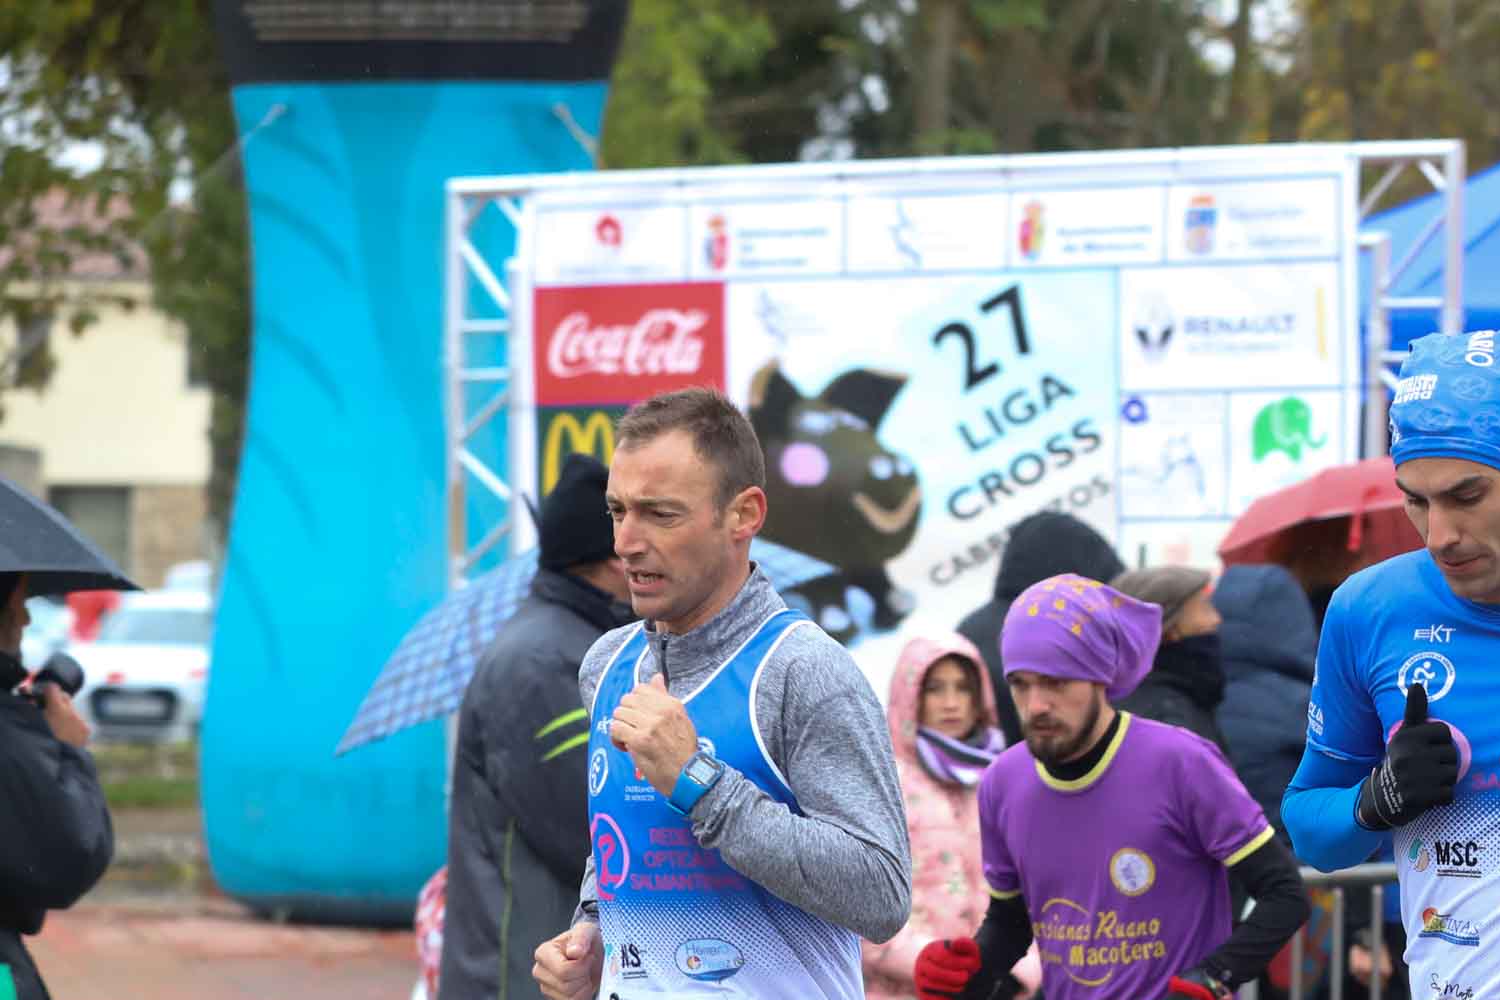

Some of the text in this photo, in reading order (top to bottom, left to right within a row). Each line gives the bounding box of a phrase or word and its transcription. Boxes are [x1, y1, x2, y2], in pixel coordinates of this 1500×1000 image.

[933, 283, 1032, 391] 27
[1184, 314, 1297, 334] RENAULT
[958, 375, 1075, 452] LIGA
[947, 418, 1102, 521] CROSS
[1435, 841, 1478, 867] MSC
[1069, 940, 1167, 967] Macotera
